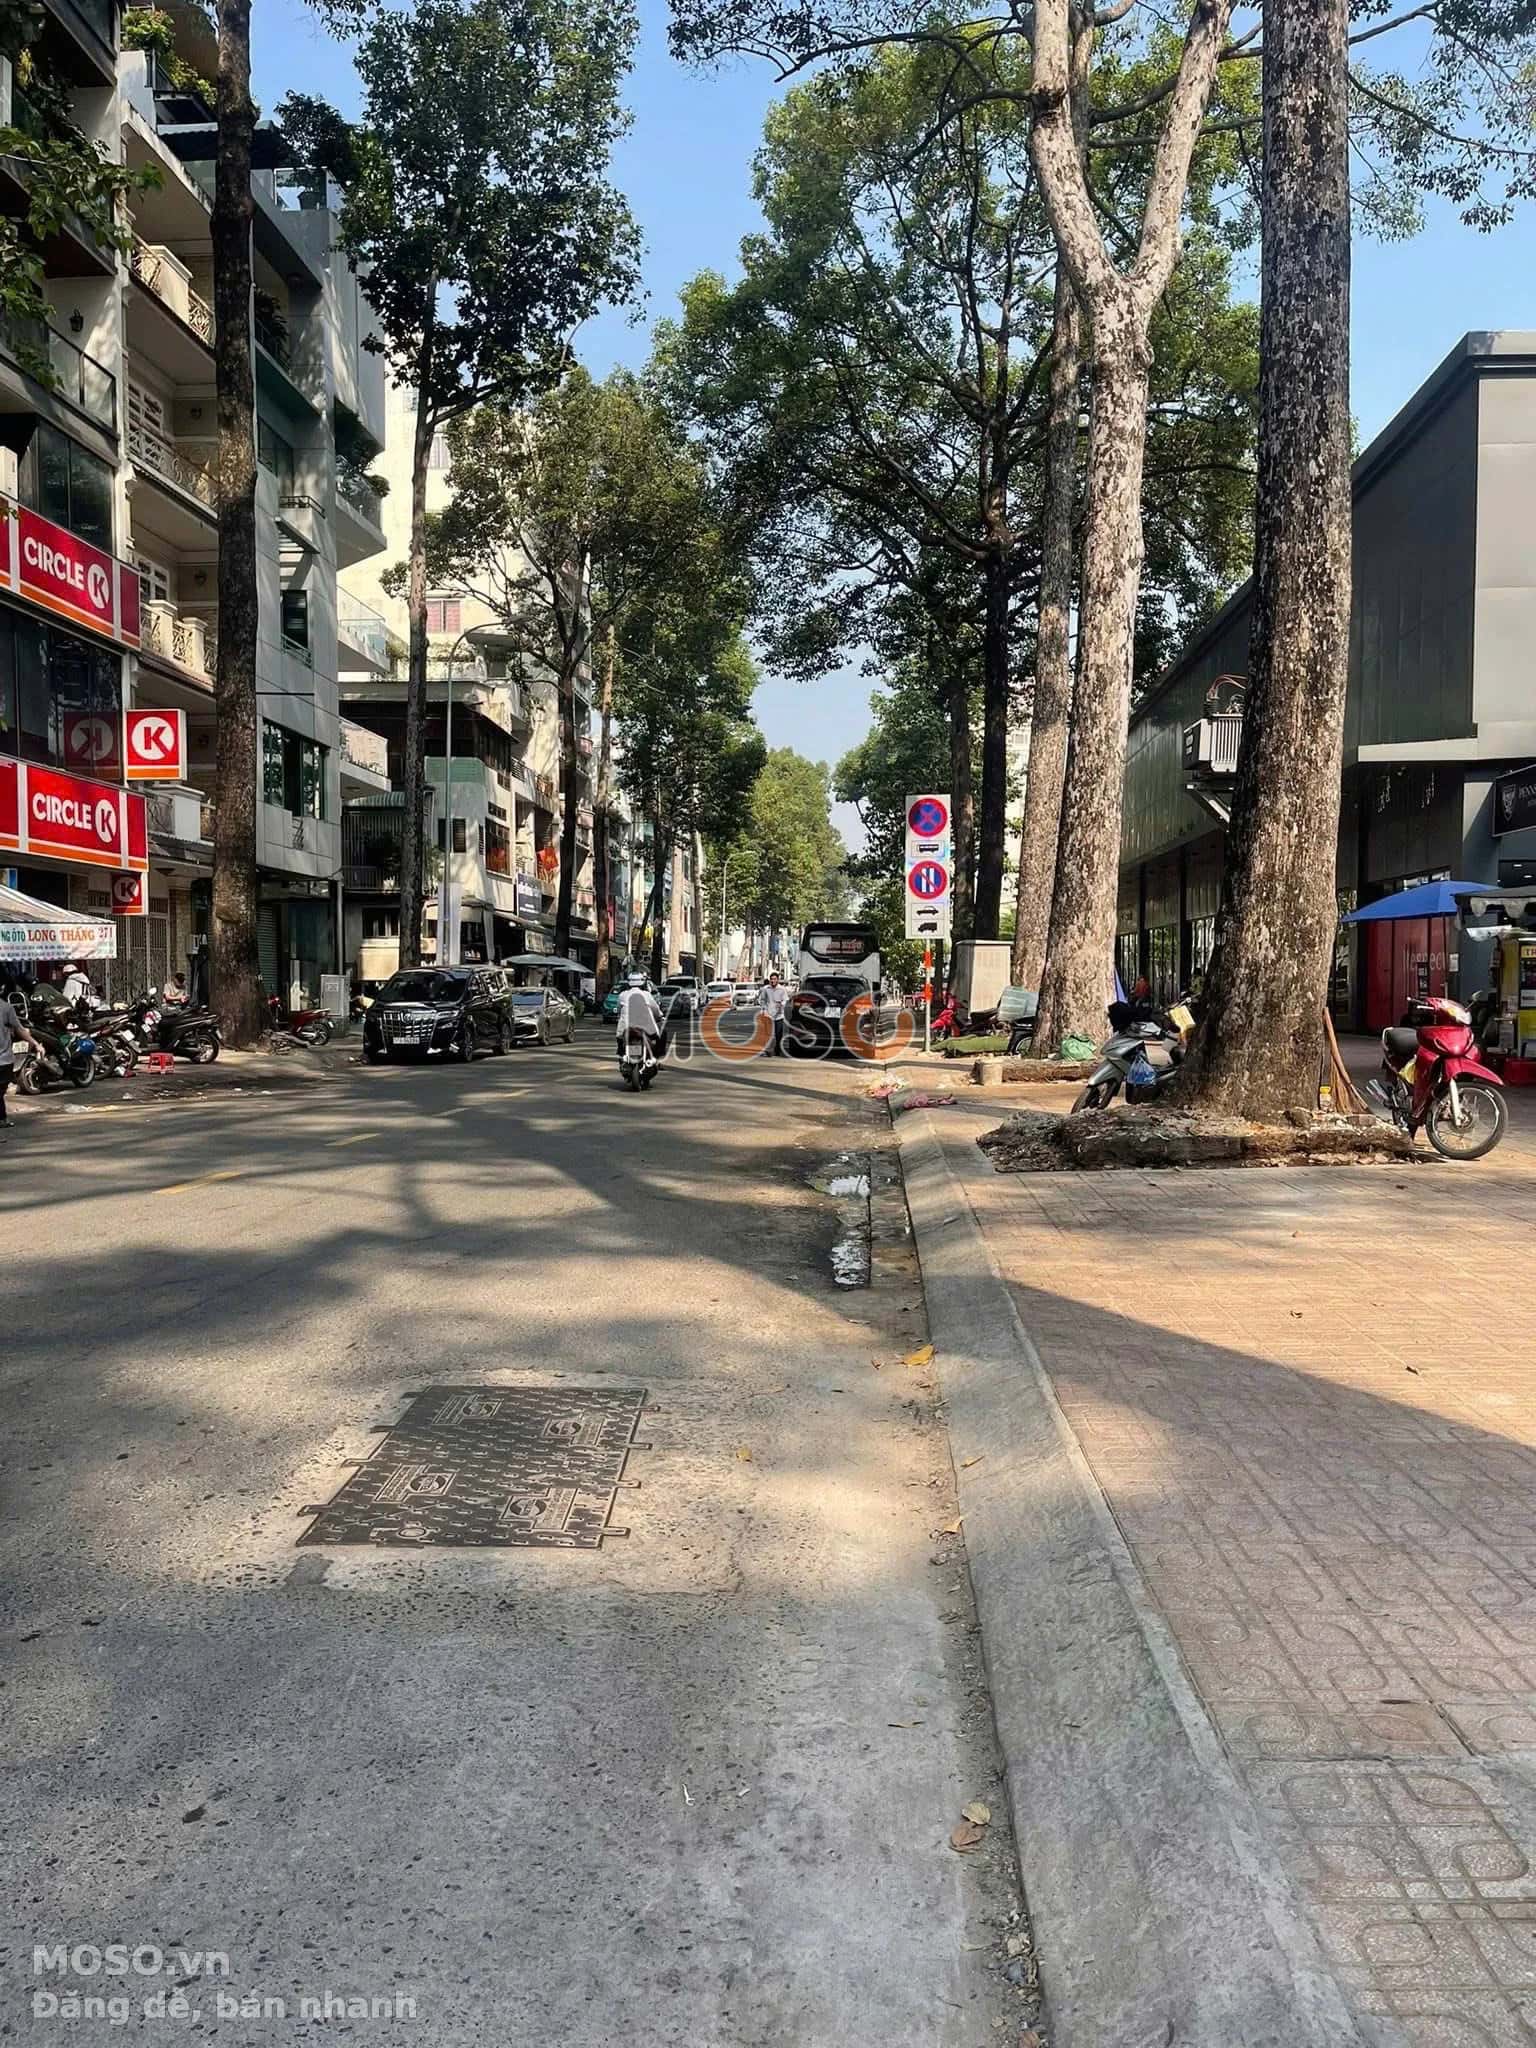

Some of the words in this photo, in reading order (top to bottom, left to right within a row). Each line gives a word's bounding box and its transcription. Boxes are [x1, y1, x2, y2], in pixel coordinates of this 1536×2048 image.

[24, 536, 85, 591] CIRCLE
[91, 569, 110, 608] K
[32, 792, 93, 830] CIRCLE
[99, 806, 117, 842] K
[27, 929, 57, 942] LONG
